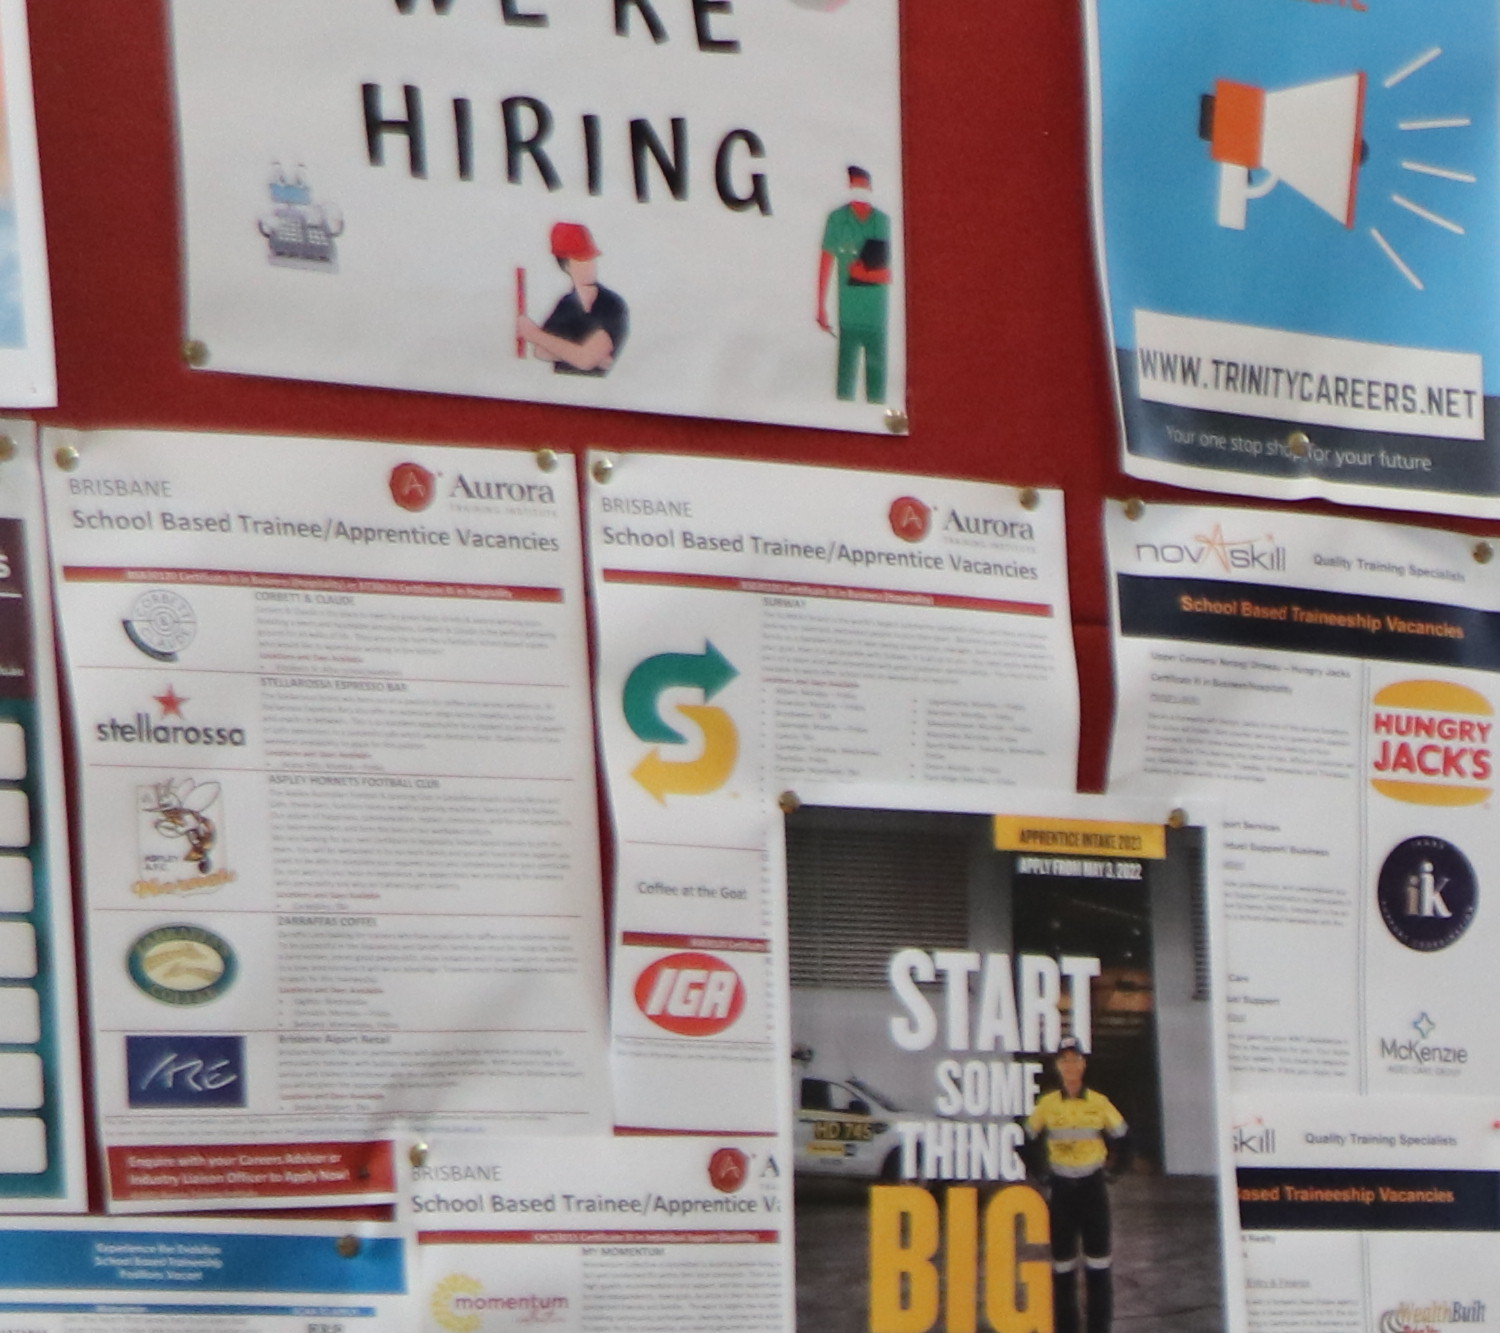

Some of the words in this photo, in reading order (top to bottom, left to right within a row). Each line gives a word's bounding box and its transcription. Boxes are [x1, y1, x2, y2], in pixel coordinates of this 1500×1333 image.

[362, 83, 773, 216] HIRING
[1140, 348, 1477, 420] WWW.TRINITYCAREERS.NET
[1166, 426, 1194, 444] Your
[1201, 433, 1226, 449] one
[1232, 437, 1262, 455] stop
[1306, 443, 1330, 462] for
[1335, 449, 1375, 468] your
[1380, 453, 1432, 471] future
[69, 478, 172, 497] BRISBANE
[449, 474, 555, 503] Aurora
[73, 511, 152, 530] School
[163, 513, 231, 533] Based
[239, 515, 450, 546] Trainee/Apprentice
[456, 527, 560, 551] Vacancies
[1314, 554, 1352, 571] Quality
[1358, 559, 1405, 576] Training
[1409, 563, 1464, 583] Specialists
[1181, 596, 1236, 616] School
[1242, 601, 1286, 621] Based
[1293, 607, 1381, 632] Traineeship
[1387, 616, 1464, 639] Vacancies
[97, 713, 246, 745] stellarossa
[1374, 714, 1492, 742] HUNGRY
[1373, 741, 1492, 780] JACK'S
[648, 969, 735, 1020] IGA
[889, 948, 1100, 1053] START
[1381, 1039, 1468, 1064] McKenzie
[937, 1060, 1043, 1117] SOME
[900, 1121, 1026, 1181] THING
